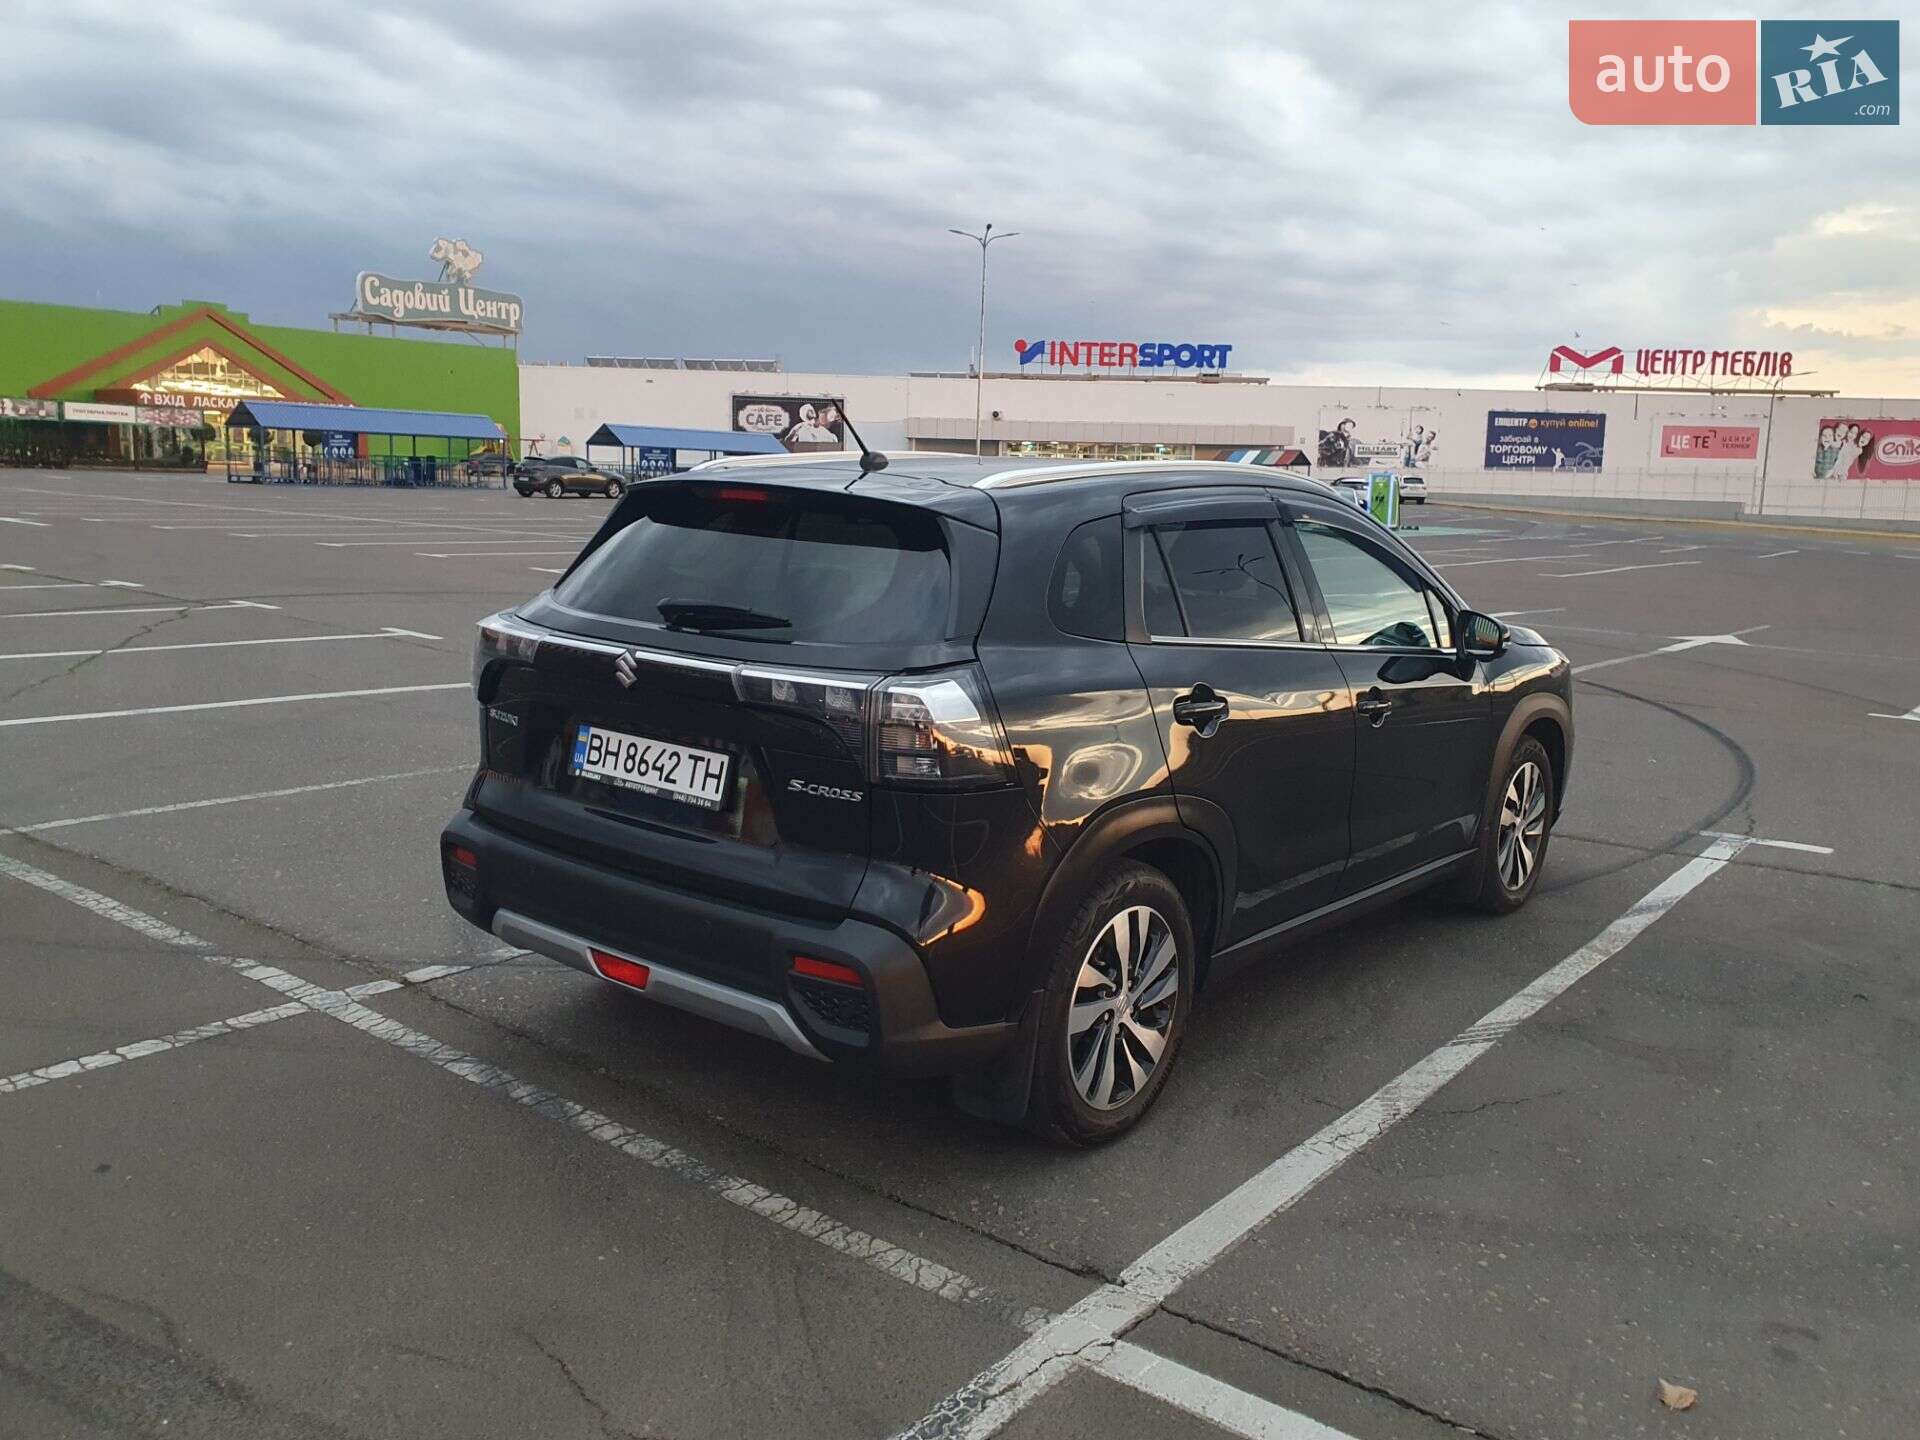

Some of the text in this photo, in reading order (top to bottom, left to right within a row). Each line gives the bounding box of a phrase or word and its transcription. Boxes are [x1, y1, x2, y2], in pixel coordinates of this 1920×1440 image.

[364, 276, 520, 328] Садовий Центр
[1049, 341, 1233, 369] INTERSPORT
[1635, 348, 1706, 377] ЦЕНТР
[1710, 350, 1793, 378] МЕБЛІВ
[153, 393, 186, 407] ВХІД
[745, 413, 783, 427] CAFE
[1490, 444, 1548, 455] ТОРГОВОМУ
[574, 752, 584, 763] UA
[623, 741, 681, 785] 8642
[787, 778, 864, 802] S-CROSS
